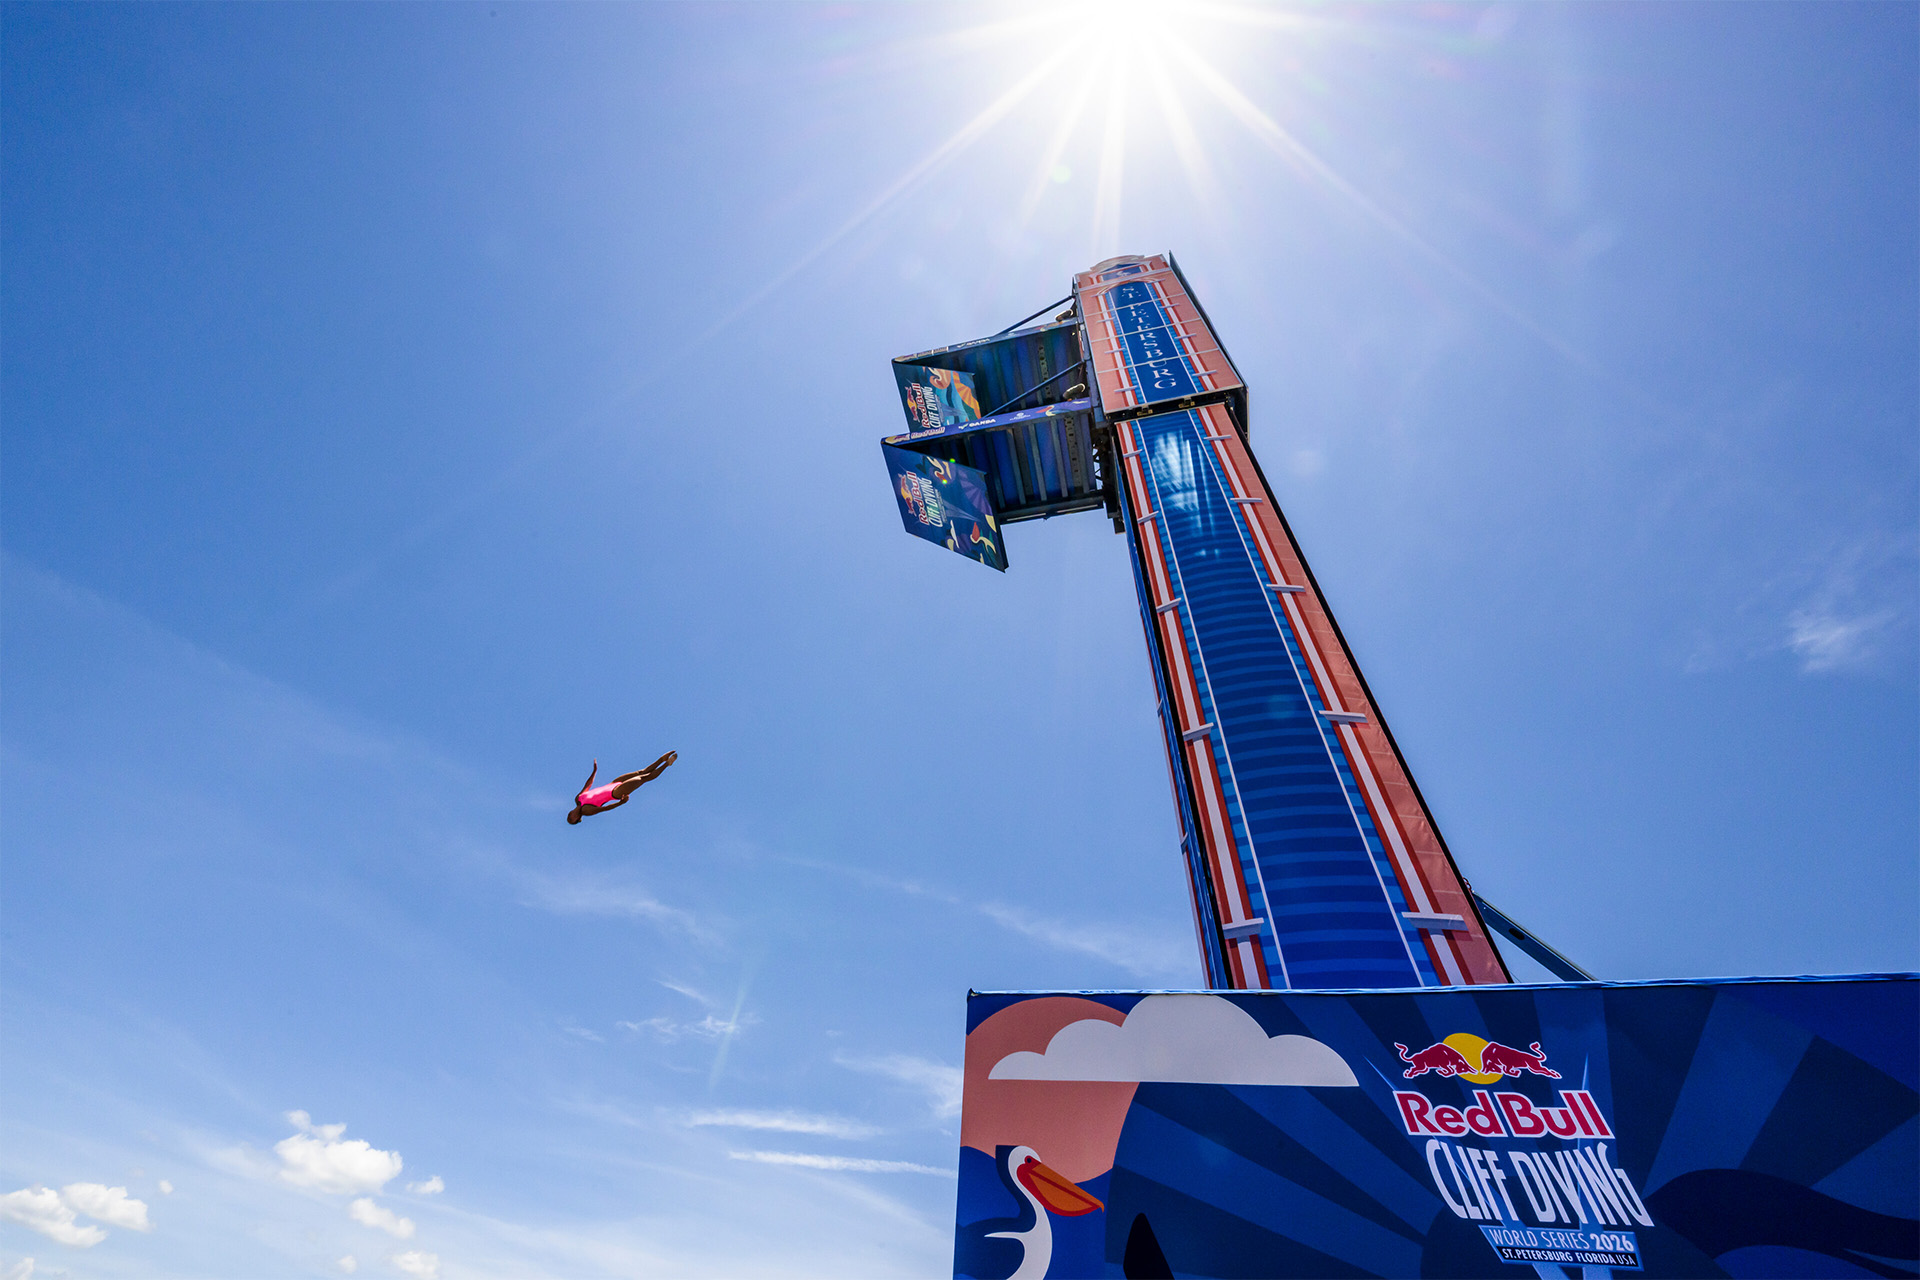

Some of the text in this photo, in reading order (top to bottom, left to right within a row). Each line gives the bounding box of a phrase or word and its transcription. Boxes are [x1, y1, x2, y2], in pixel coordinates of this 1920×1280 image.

[1130, 303, 1177, 389] PETERSBURG
[911, 382, 931, 428] Red Bull
[922, 386, 938, 411] DIVING
[928, 410, 942, 428] CLIFF
[906, 470, 930, 525] Red Bull
[918, 477, 939, 507] DIVING
[926, 506, 943, 527] CLIFF
[1392, 1089, 1616, 1140] Red Bull
[1425, 1138, 1655, 1227] CLIFF DIVING
[1489, 1228, 1635, 1252] WORLD SERIES 2026
[1575, 1252, 1616, 1264] FLORIDA
[1616, 1253, 1637, 1266] USA
